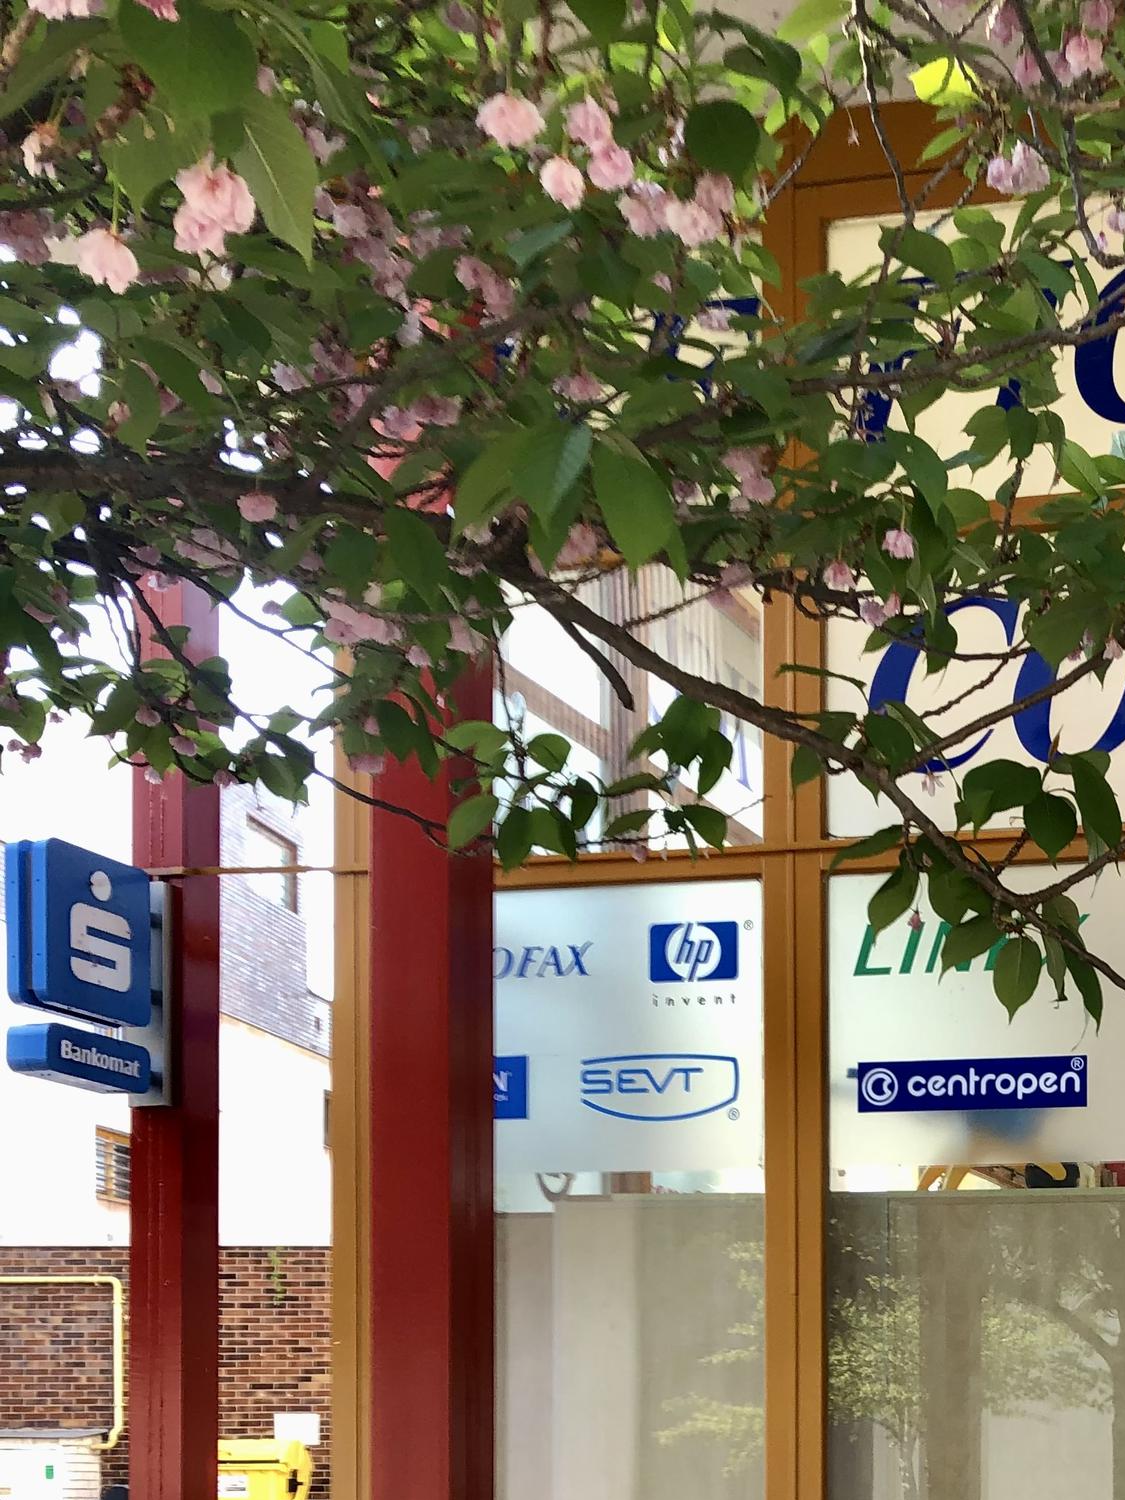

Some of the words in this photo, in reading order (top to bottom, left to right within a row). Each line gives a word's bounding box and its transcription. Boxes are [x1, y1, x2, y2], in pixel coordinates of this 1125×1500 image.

[674, 922, 714, 982] hp
[652, 993, 737, 1007] invent
[60, 1039, 141, 1078] Bankomat
[581, 1066, 703, 1094] SEVT
[907, 1061, 1081, 1100] centropen
